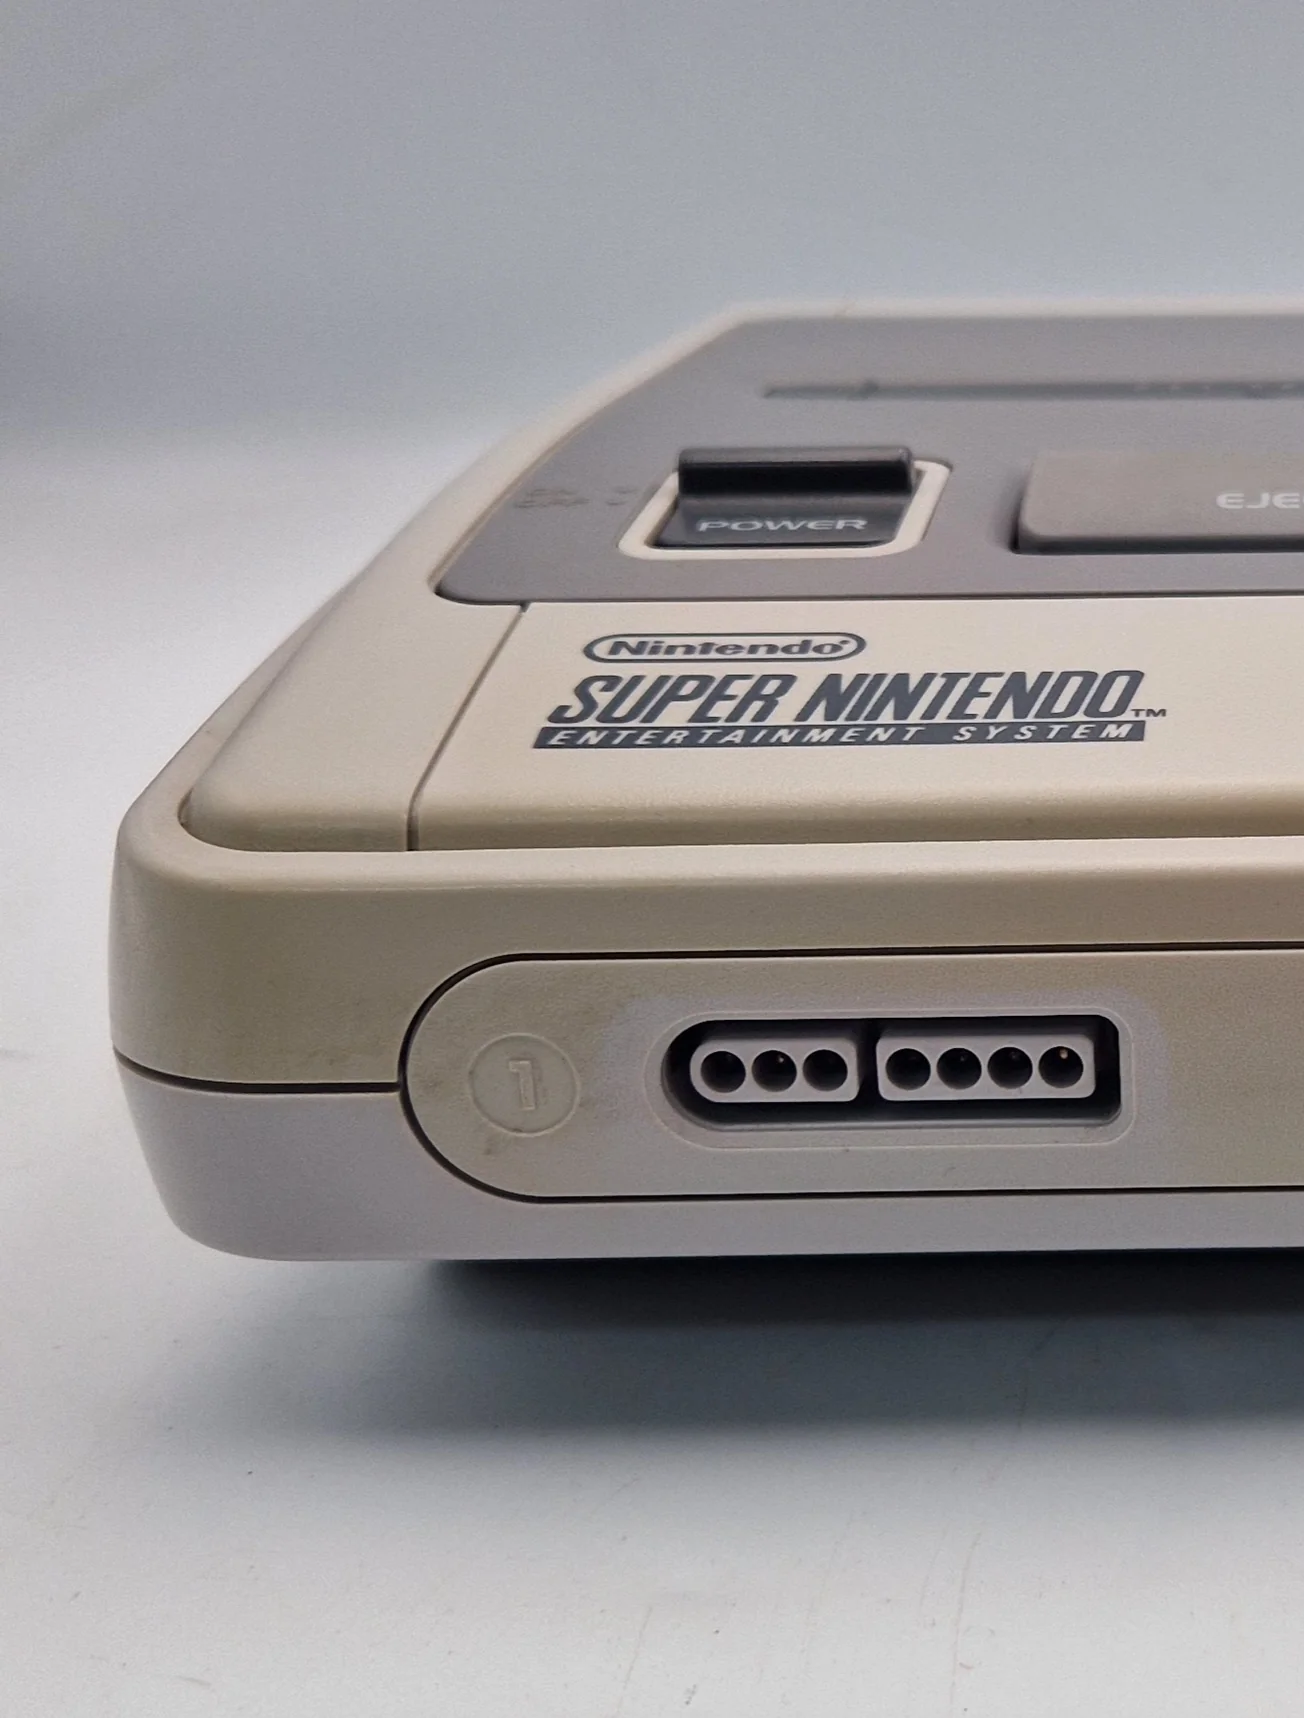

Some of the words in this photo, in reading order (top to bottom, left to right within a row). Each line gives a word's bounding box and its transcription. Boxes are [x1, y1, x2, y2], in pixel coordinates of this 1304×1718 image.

[696, 516, 869, 532] POWER
[547, 673, 798, 725] SUPER
[795, 669, 1145, 723] NINTENDO
[547, 726, 926, 747] ENTERTAINMENT
[952, 723, 1134, 742] SYSTEM
[509, 1060, 535, 1110] 1
